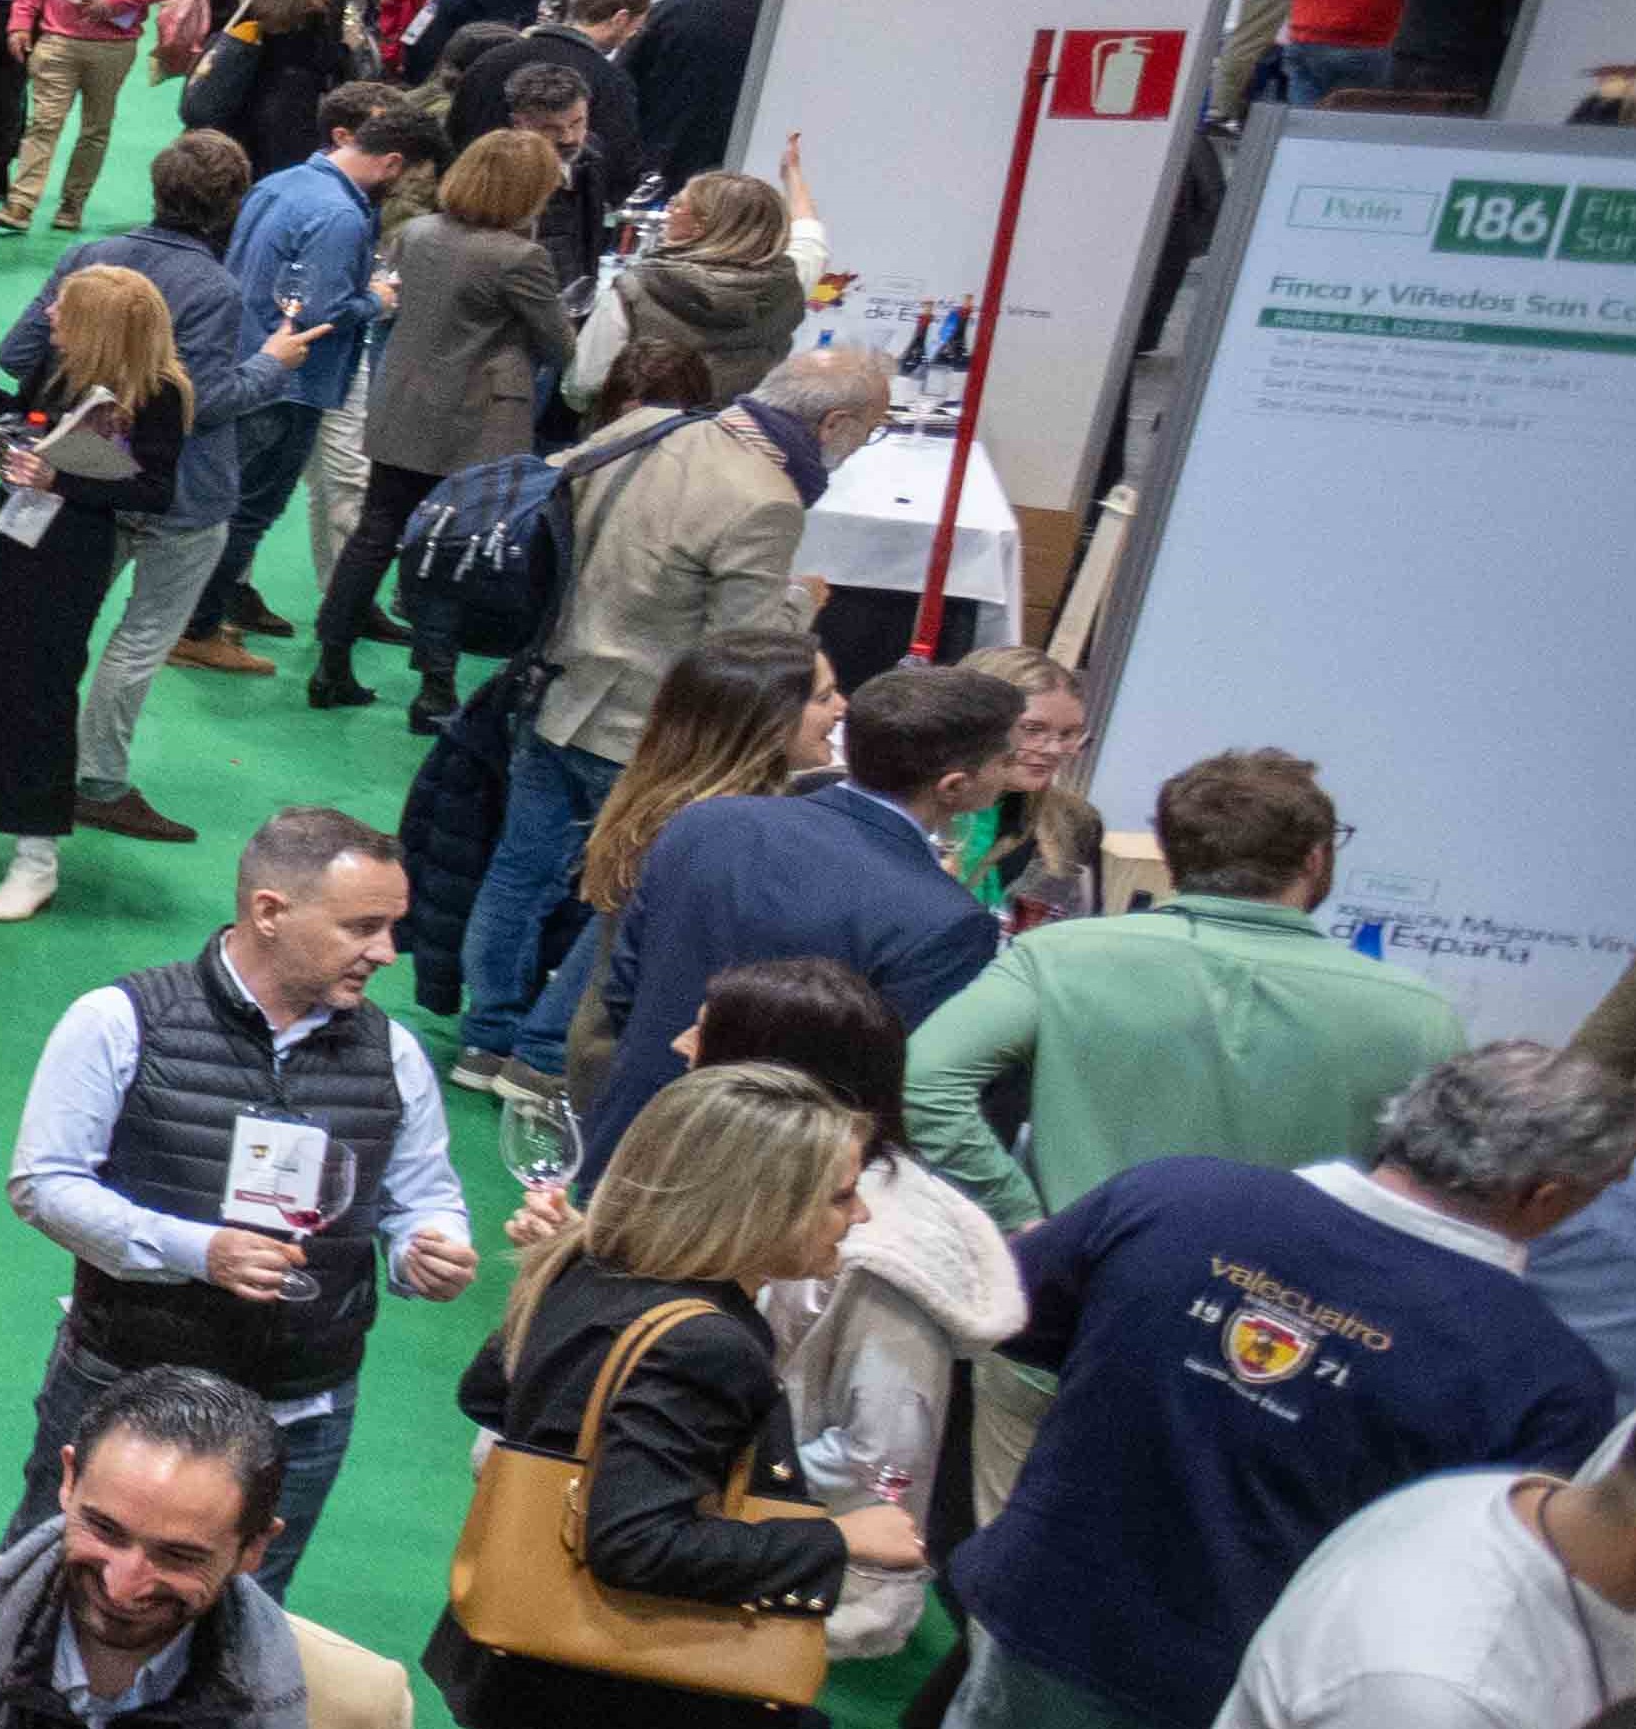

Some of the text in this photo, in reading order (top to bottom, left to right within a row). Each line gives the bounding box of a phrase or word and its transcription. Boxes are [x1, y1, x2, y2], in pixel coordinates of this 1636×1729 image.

[1453, 196, 1550, 243] 186
[1269, 274, 1588, 319] Finca y Viñedos San
